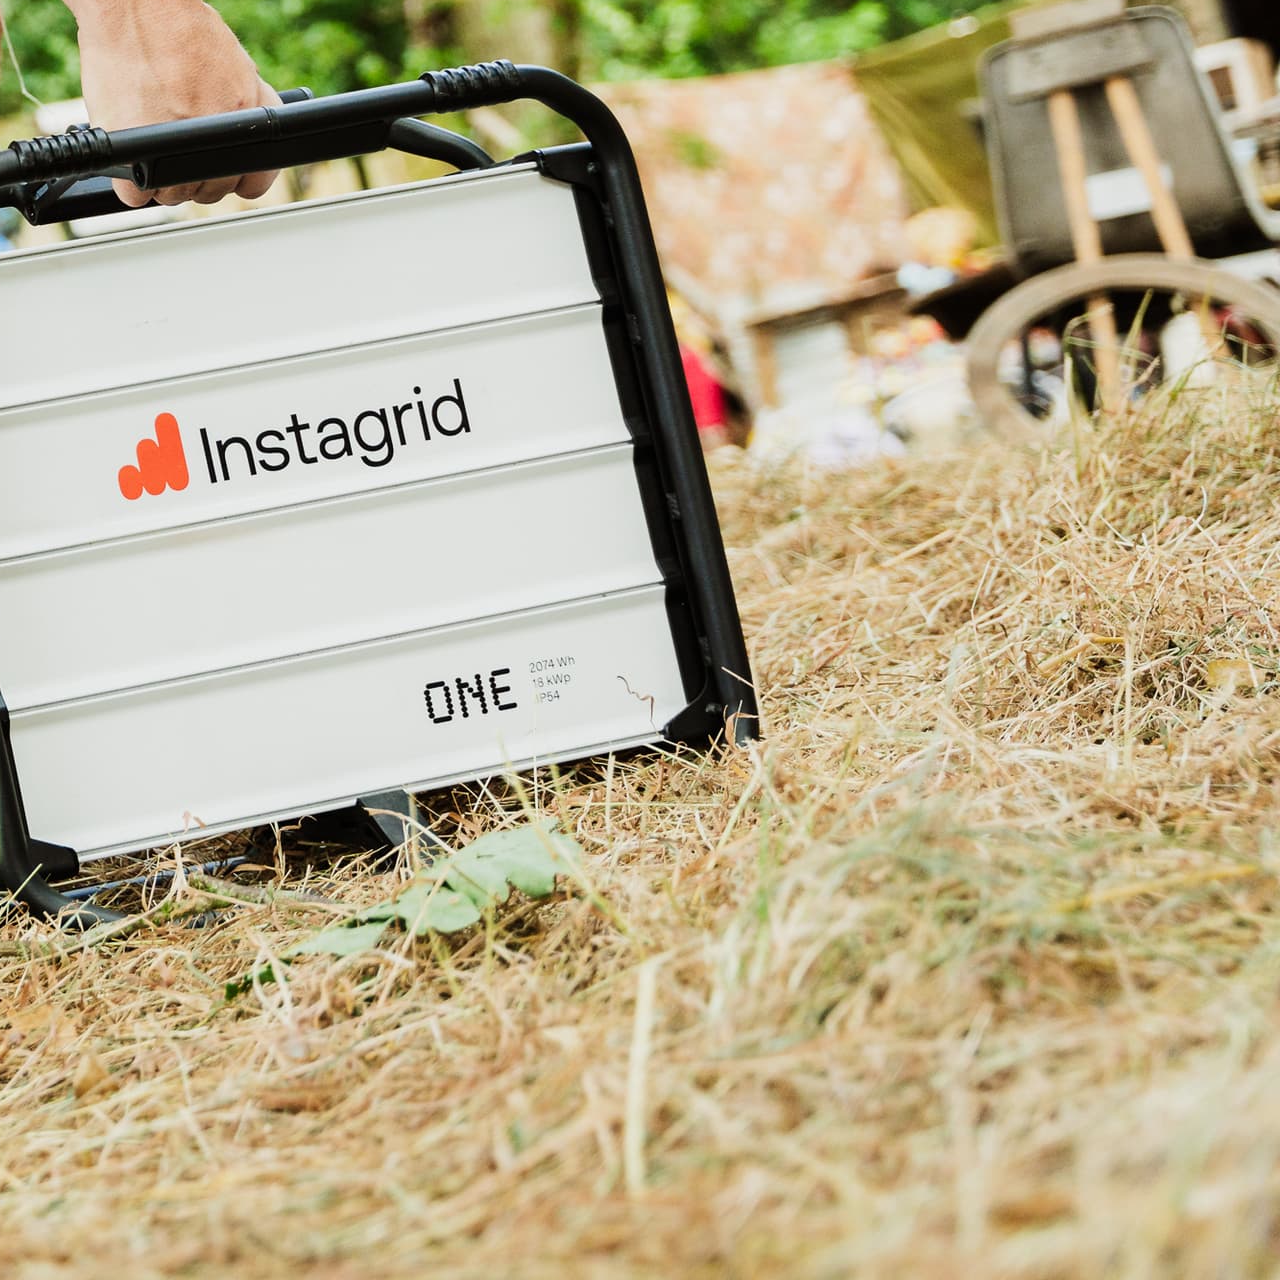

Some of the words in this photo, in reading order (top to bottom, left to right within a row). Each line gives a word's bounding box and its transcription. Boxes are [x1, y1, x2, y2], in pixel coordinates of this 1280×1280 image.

[200, 378, 471, 483] Instagrid
[529, 659, 555, 673] 2074
[556, 656, 576, 668] Wh
[546, 673, 571, 686] kWp
[424, 667, 517, 724] ONE
